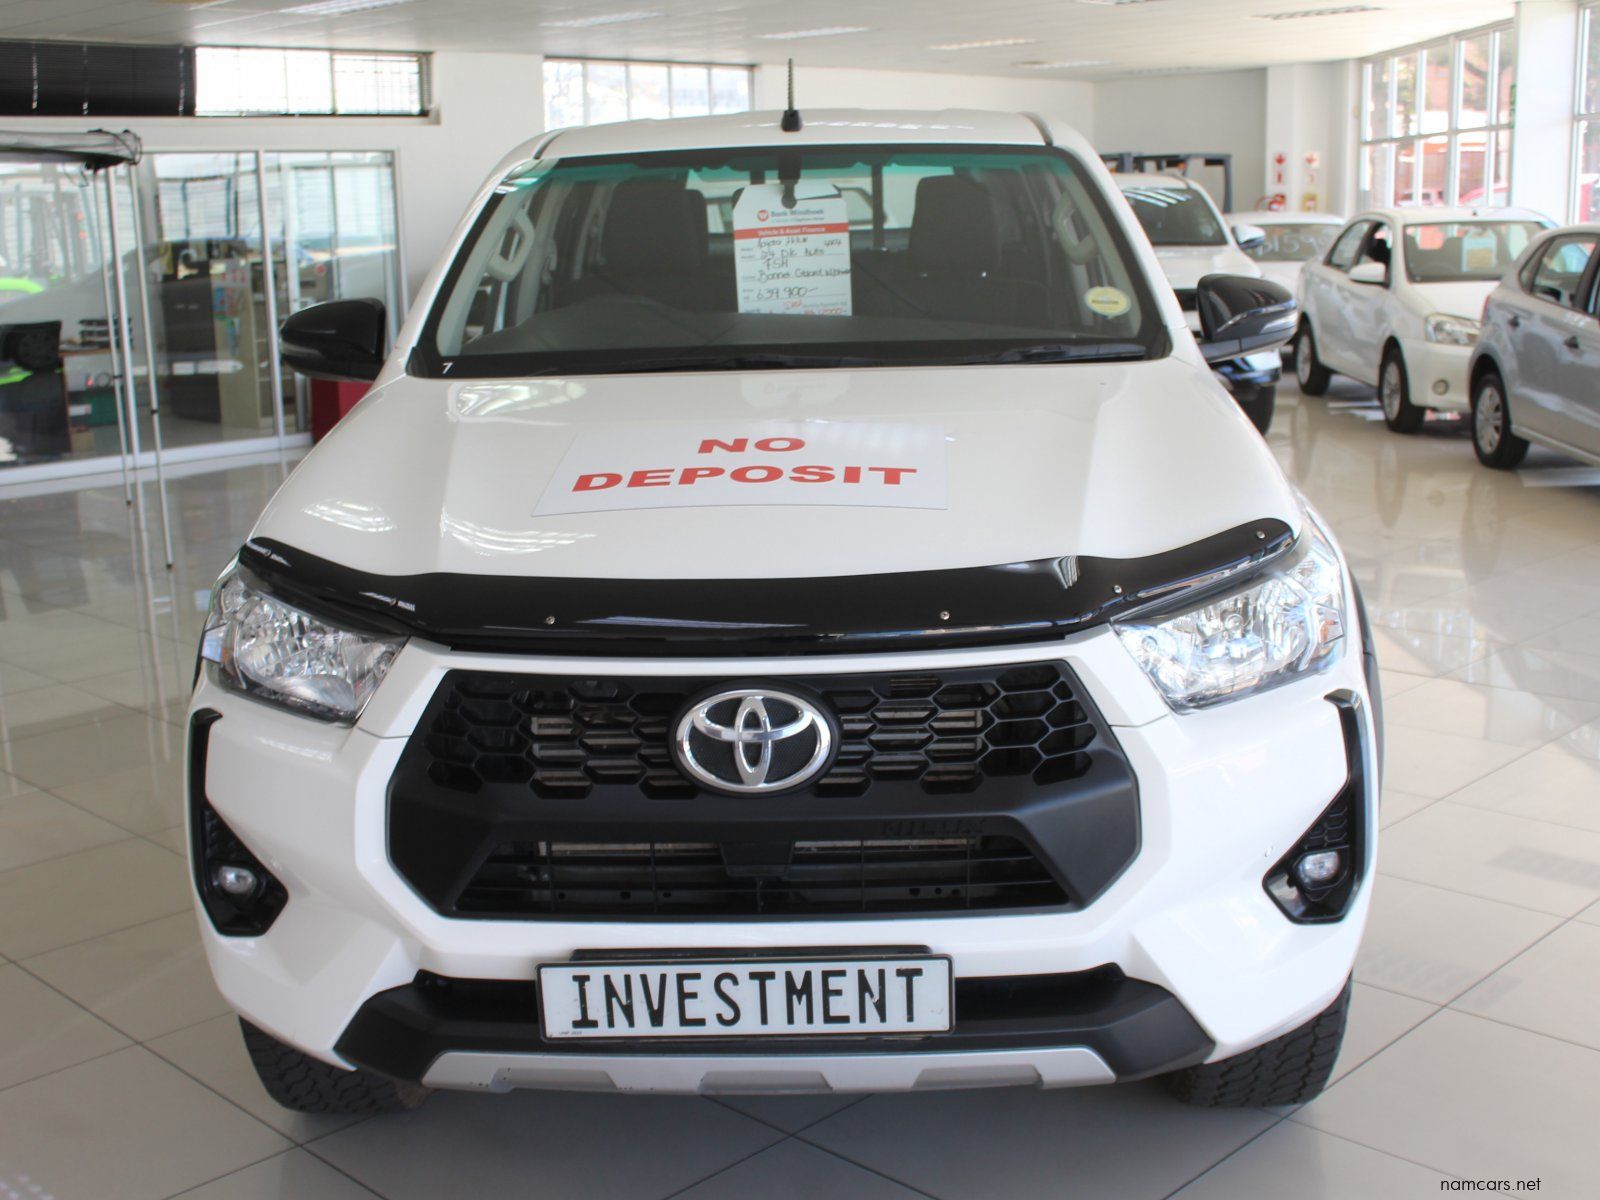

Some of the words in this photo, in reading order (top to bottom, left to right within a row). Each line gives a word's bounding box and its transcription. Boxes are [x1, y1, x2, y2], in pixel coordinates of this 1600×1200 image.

[697, 437, 807, 454] NO
[572, 465, 917, 492] DEPOSIT
[572, 968, 923, 1028] INVESTMENT
